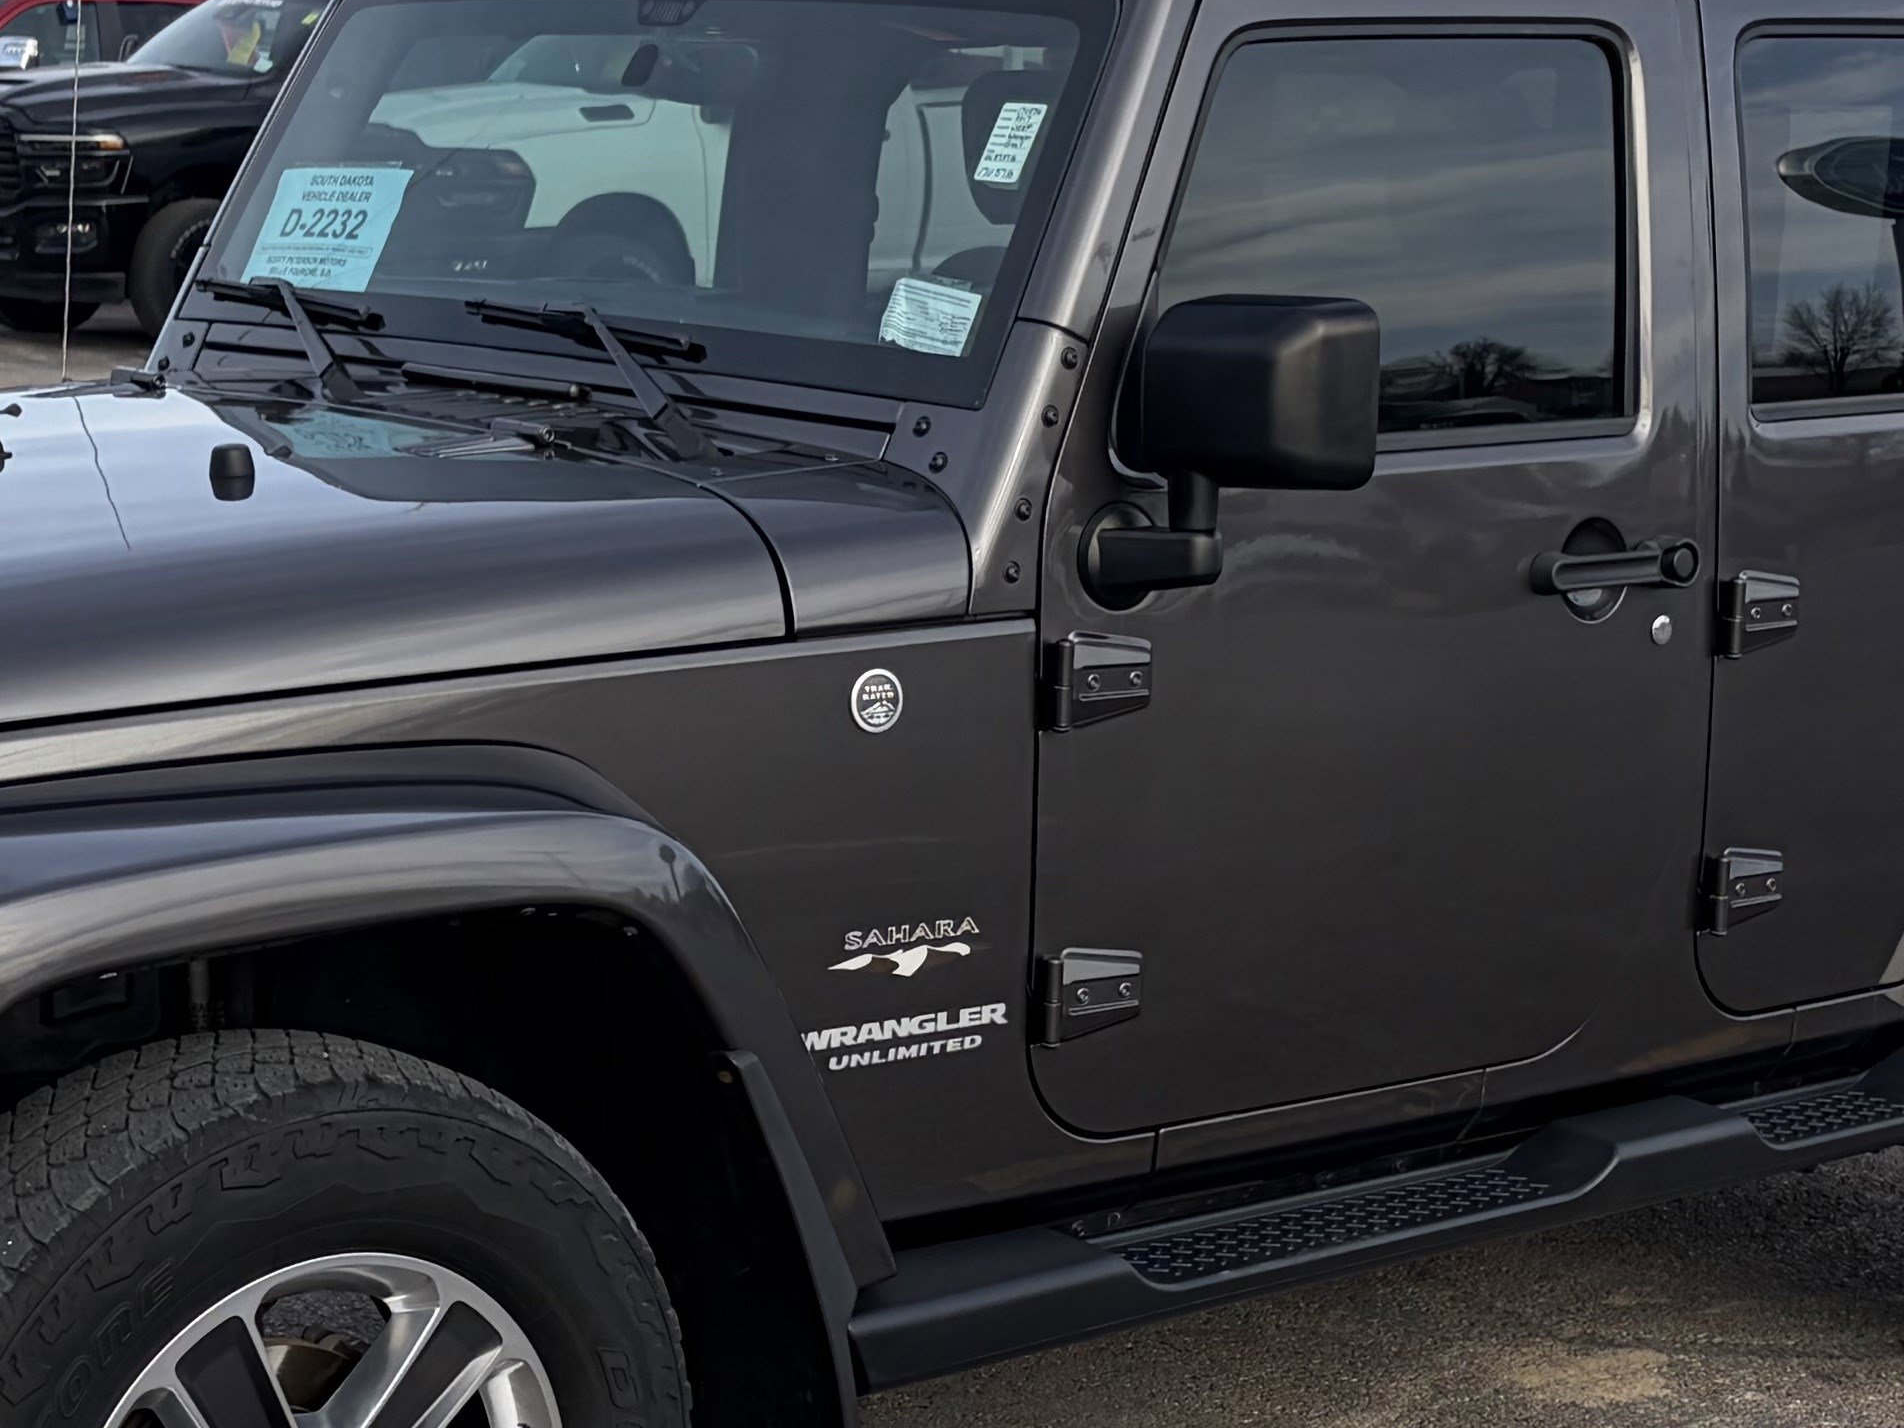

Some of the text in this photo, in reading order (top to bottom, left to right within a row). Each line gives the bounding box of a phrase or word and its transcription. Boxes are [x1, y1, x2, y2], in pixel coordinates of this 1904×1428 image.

[301, 190, 373, 203] VEHICLE DEALER
[309, 174, 375, 188] SOUTH DAKOTA
[279, 207, 369, 241] D-2232
[843, 916, 980, 951] SAHARA
[801, 1002, 1008, 1052] WRANGLER
[828, 1033, 983, 1071] UNLIMITED
